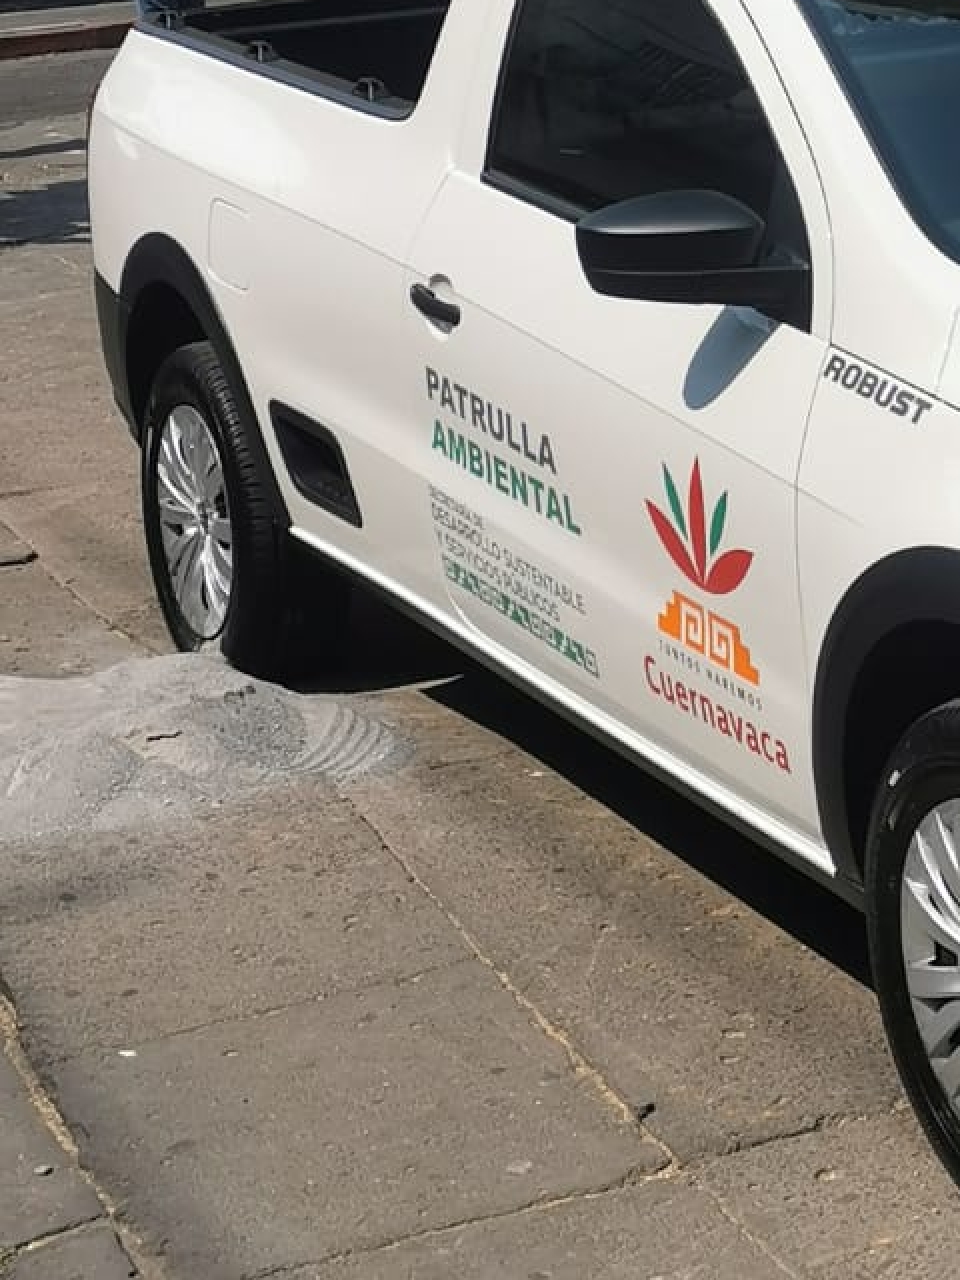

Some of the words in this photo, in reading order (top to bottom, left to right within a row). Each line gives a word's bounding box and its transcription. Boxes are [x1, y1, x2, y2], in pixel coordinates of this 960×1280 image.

[425, 365, 557, 475] PATRULLA
[824, 354, 934, 424] ROBUST
[432, 419, 582, 536] AMBIENTAL
[644, 655, 792, 774] Cuernavaca
